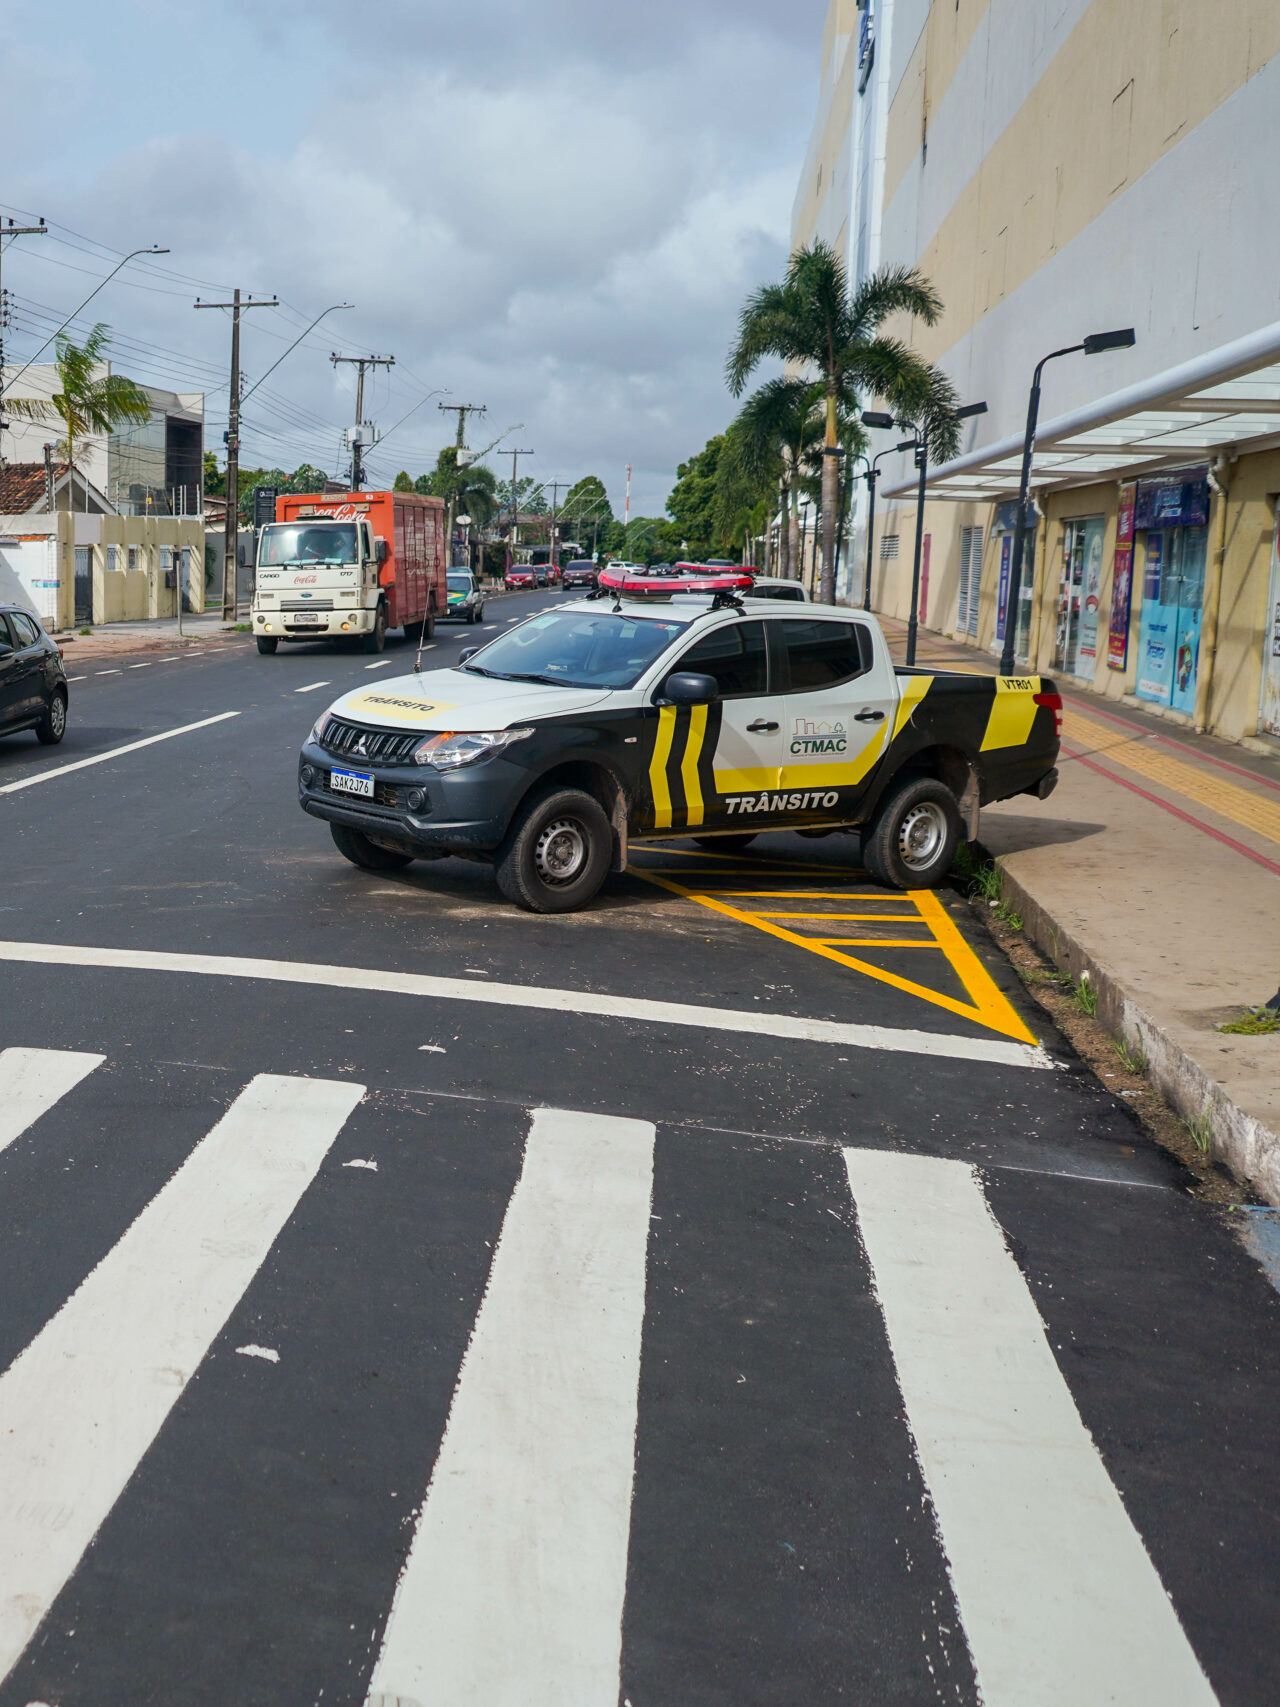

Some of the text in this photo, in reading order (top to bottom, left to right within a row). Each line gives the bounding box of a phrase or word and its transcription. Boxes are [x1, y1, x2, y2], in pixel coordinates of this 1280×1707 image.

[1002, 679, 1034, 690] VTR01
[790, 738, 848, 754] CTMAC
[334, 775, 369, 794] SAK2J76
[725, 791, 840, 815] TRÂNSITO
